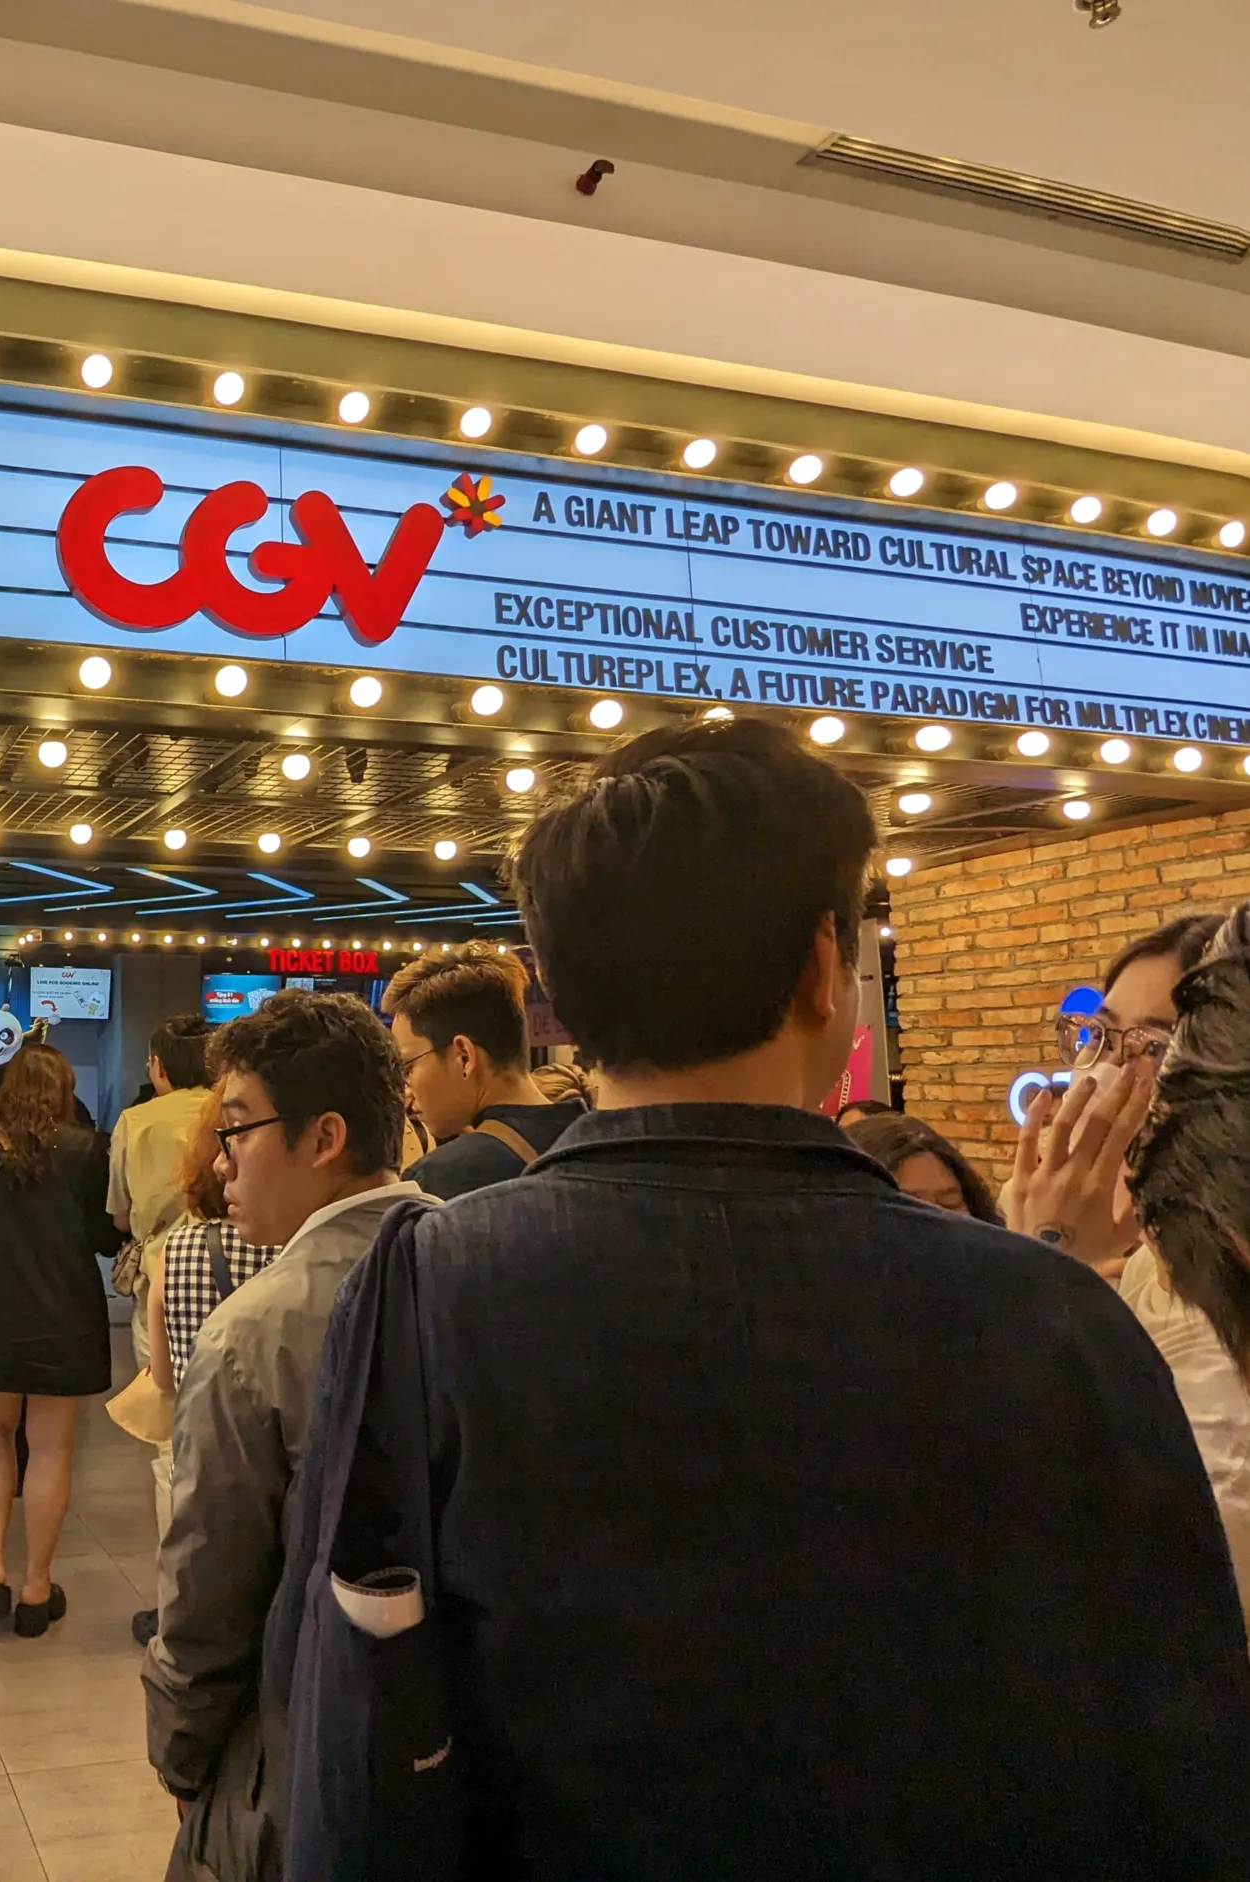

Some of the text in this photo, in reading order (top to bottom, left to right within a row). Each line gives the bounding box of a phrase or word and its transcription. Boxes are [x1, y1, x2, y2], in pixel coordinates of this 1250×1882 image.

[56, 465, 445, 648] CGV
[533, 492, 555, 524] A
[564, 498, 656, 539] GIANT
[666, 510, 740, 546] LEAP
[747, 519, 871, 562] TOWARD
[879, 539, 1017, 581] CULTURAL
[1021, 555, 1098, 592] SPACE
[1102, 566, 1185, 604] BEYOND
[494, 593, 994, 674] EXCEPTIONAL CUSTOMER SERVICE
[1020, 603, 1154, 647] EXPERIENCE
[1160, 621, 1180, 649] IT
[1186, 624, 1209, 653] IN
[495, 645, 723, 701] CULTUREPLEX,
[729, 667, 752, 698] A
[757, 670, 865, 708] FUTURE
[870, 681, 1020, 723] PARADIGM
[1024, 696, 1072, 726] FOR
[1075, 701, 1191, 738] MULTIPLEX
[267, 948, 379, 973] TICKET BOX
